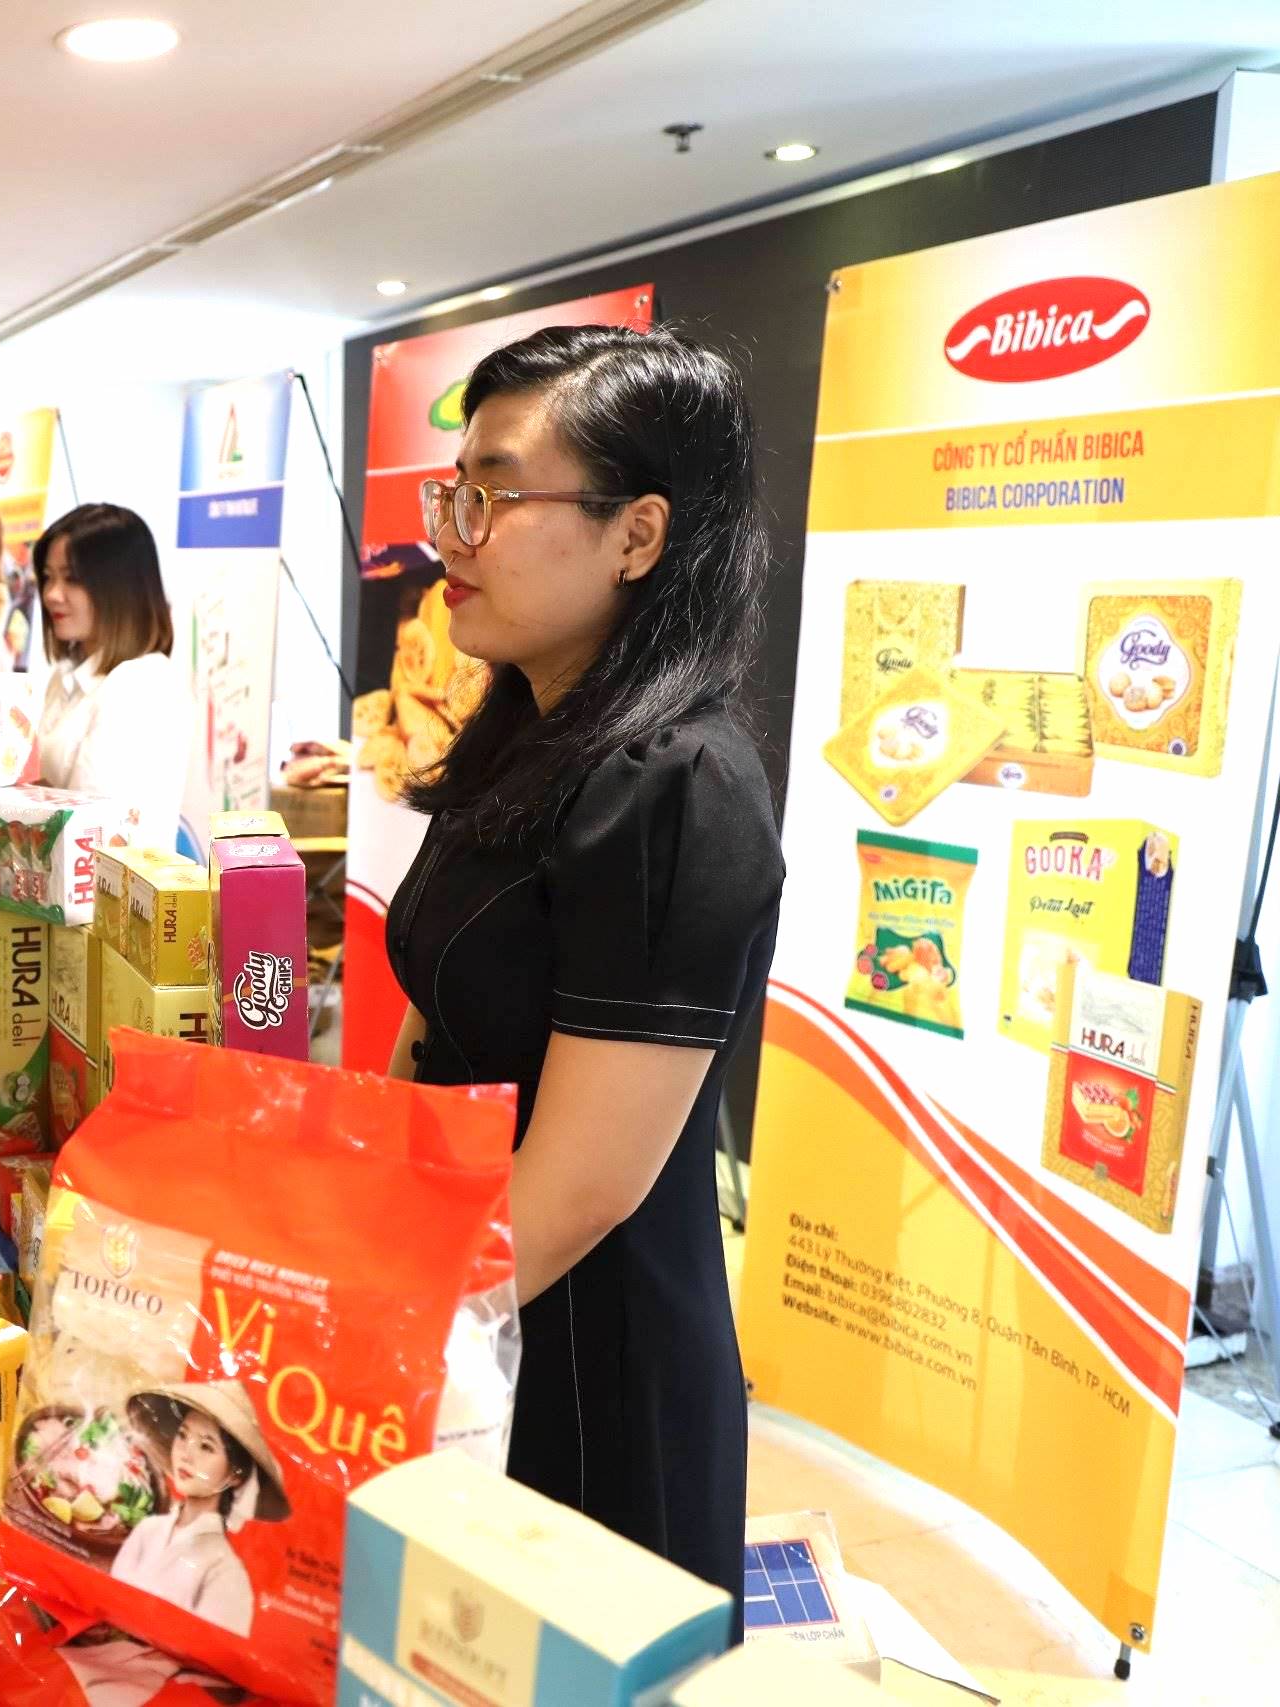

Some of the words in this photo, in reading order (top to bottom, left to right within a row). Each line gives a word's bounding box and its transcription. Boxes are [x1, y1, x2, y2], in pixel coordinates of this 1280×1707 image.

[990, 304, 1094, 357] Bibica
[932, 441, 974, 472] CÔNG
[980, 443, 999, 469] TY
[1083, 430, 1145, 460] BIBICA
[946, 485, 997, 511] BIBICA
[1003, 477, 1125, 508] CORPORATION
[74, 836, 97, 905] HURA
[1024, 845, 1103, 881] GOOKA
[163, 908, 177, 943] HURA
[11, 926, 41, 1008] HURA
[234, 951, 287, 1028] Goody
[278, 957, 292, 994] CHIPS
[12, 1012, 41, 1047] deli
[1081, 1026, 1125, 1059] HURA
[69, 1268, 163, 1316] TOFOCO
[783, 1272, 826, 1298] Email:
[782, 1292, 842, 1328] Website:
[1025, 1334, 1049, 1360] Tân
[1103, 1384, 1131, 1417] HCM
[267, 1364, 407, 1468] Quê
